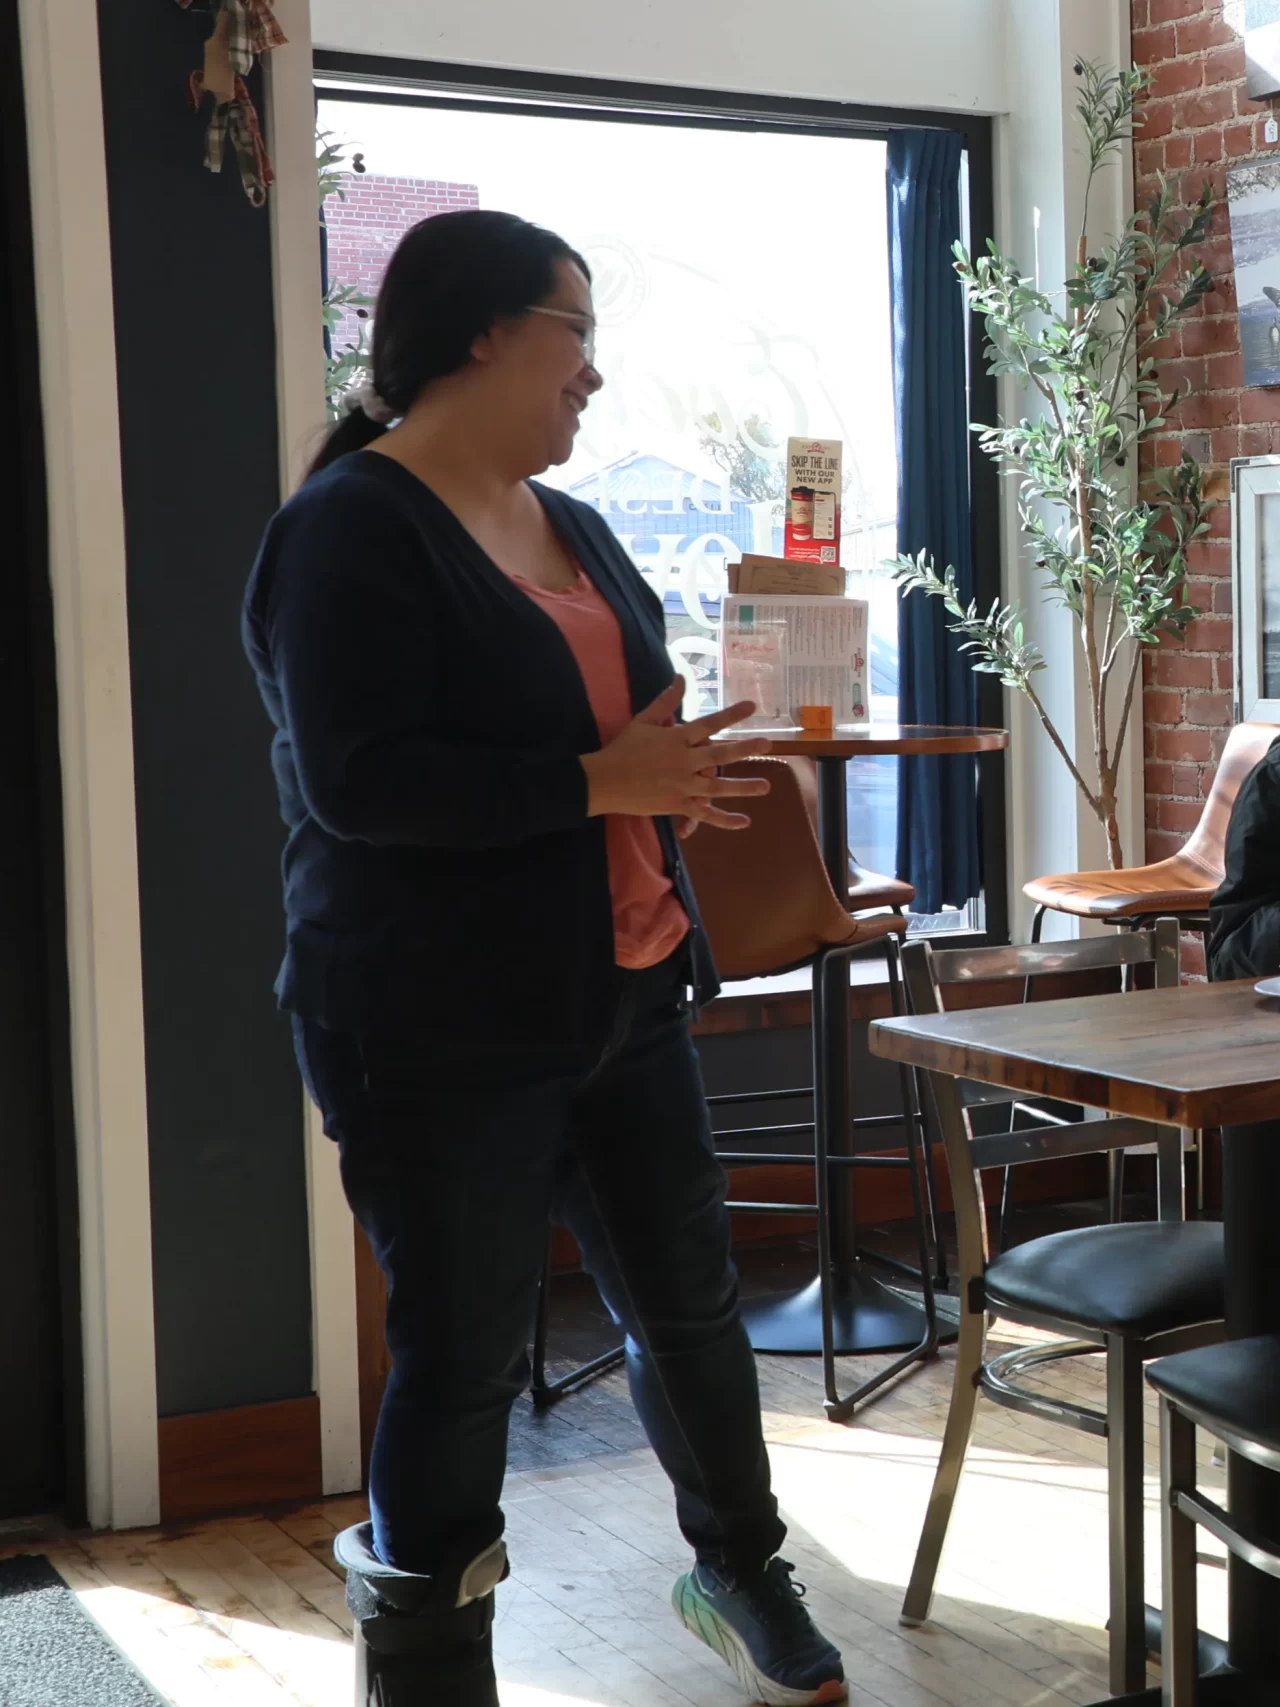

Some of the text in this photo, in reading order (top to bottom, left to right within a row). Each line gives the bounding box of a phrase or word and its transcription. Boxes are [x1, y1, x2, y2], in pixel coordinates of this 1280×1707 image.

[791, 455, 838, 470] SKIP THE LINE
